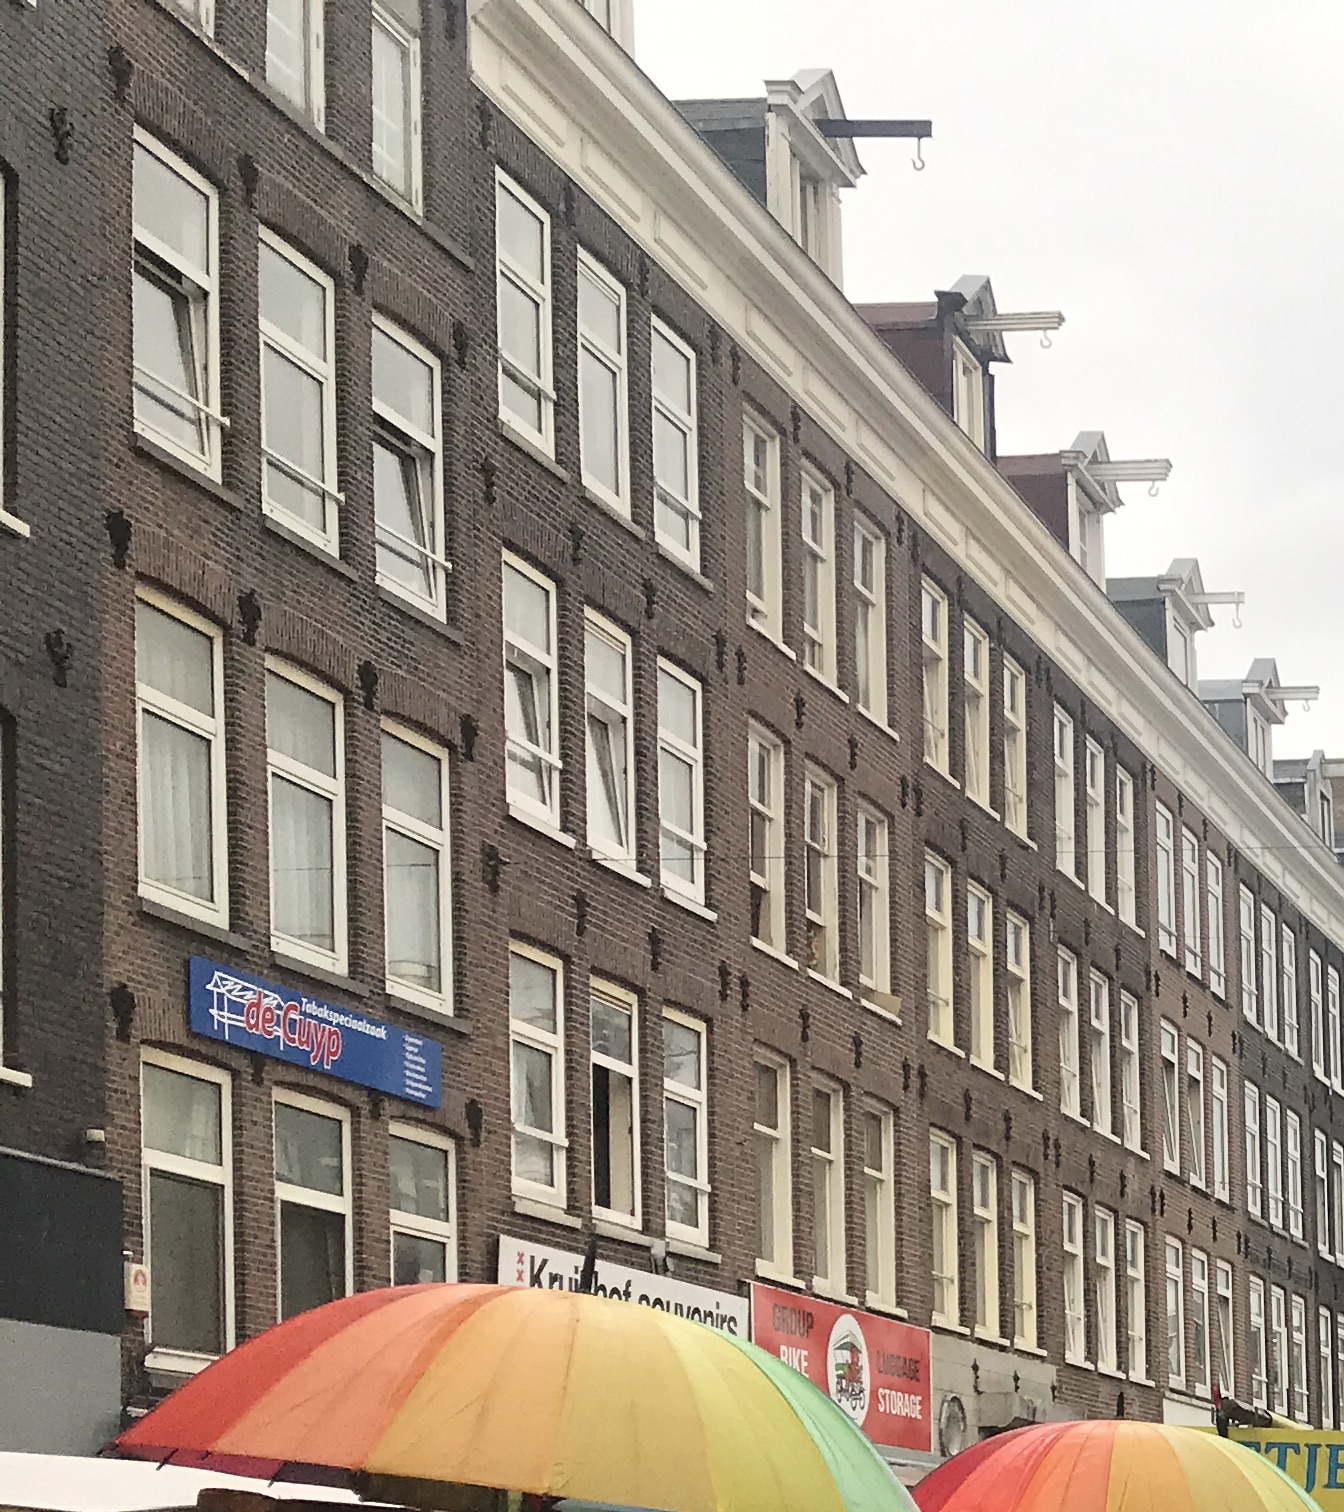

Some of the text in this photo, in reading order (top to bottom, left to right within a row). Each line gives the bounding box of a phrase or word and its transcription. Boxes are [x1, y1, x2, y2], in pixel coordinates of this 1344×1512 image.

[244, 990, 276, 1040] de
[281, 1001, 343, 1070] Cuyp
[772, 1303, 815, 1339] GROUP
[779, 1344, 810, 1378] BIKE
[877, 1387, 923, 1420] STORAGE
